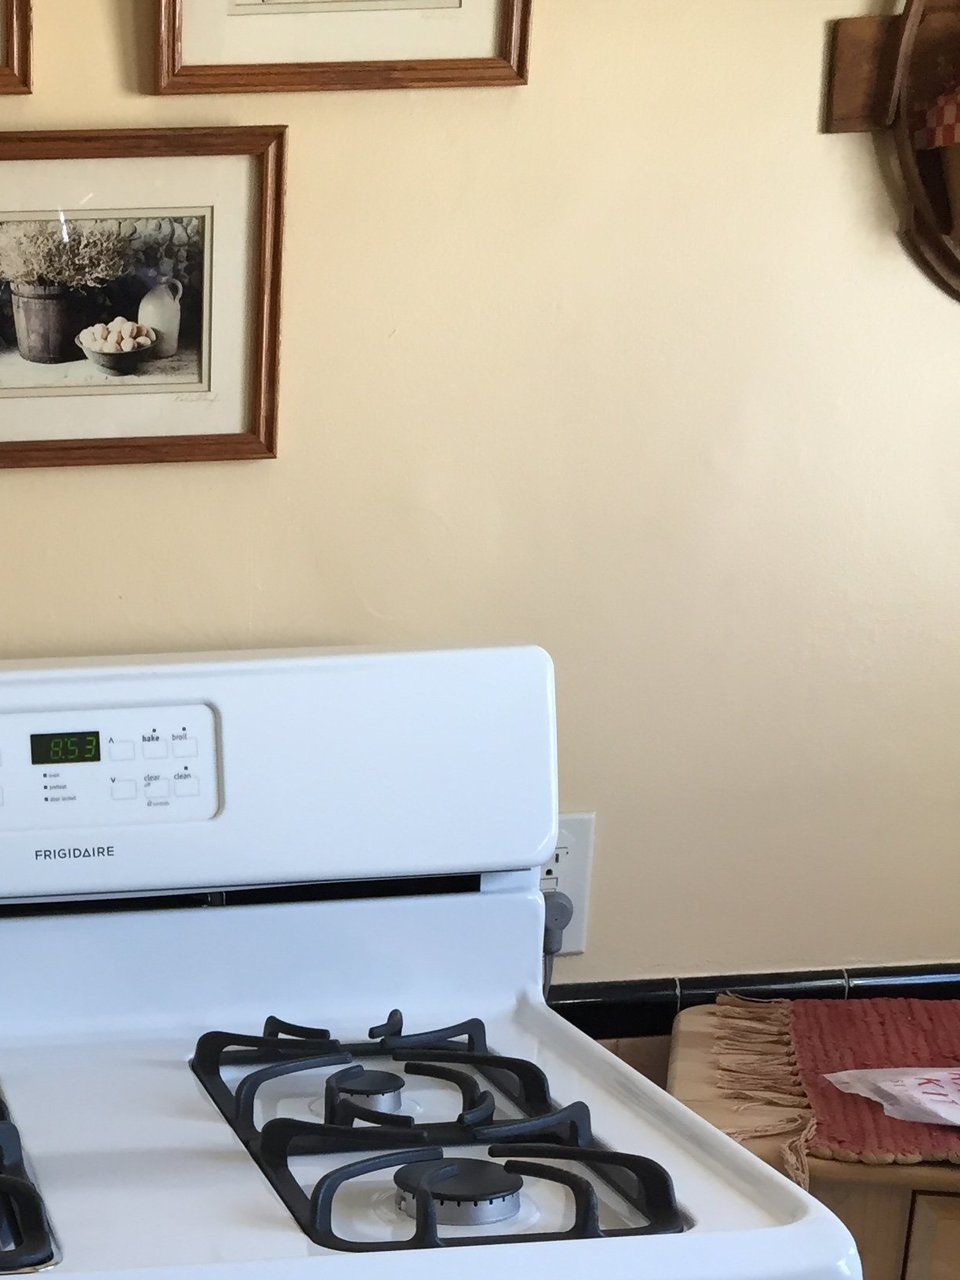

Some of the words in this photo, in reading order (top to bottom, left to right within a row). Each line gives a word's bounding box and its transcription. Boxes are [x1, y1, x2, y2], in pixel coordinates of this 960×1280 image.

[141, 734, 160, 742] bake
[171, 733, 188, 741] broil
[144, 774, 160, 782] clear
[35, 846, 115, 860] FRIGIDAIRE
